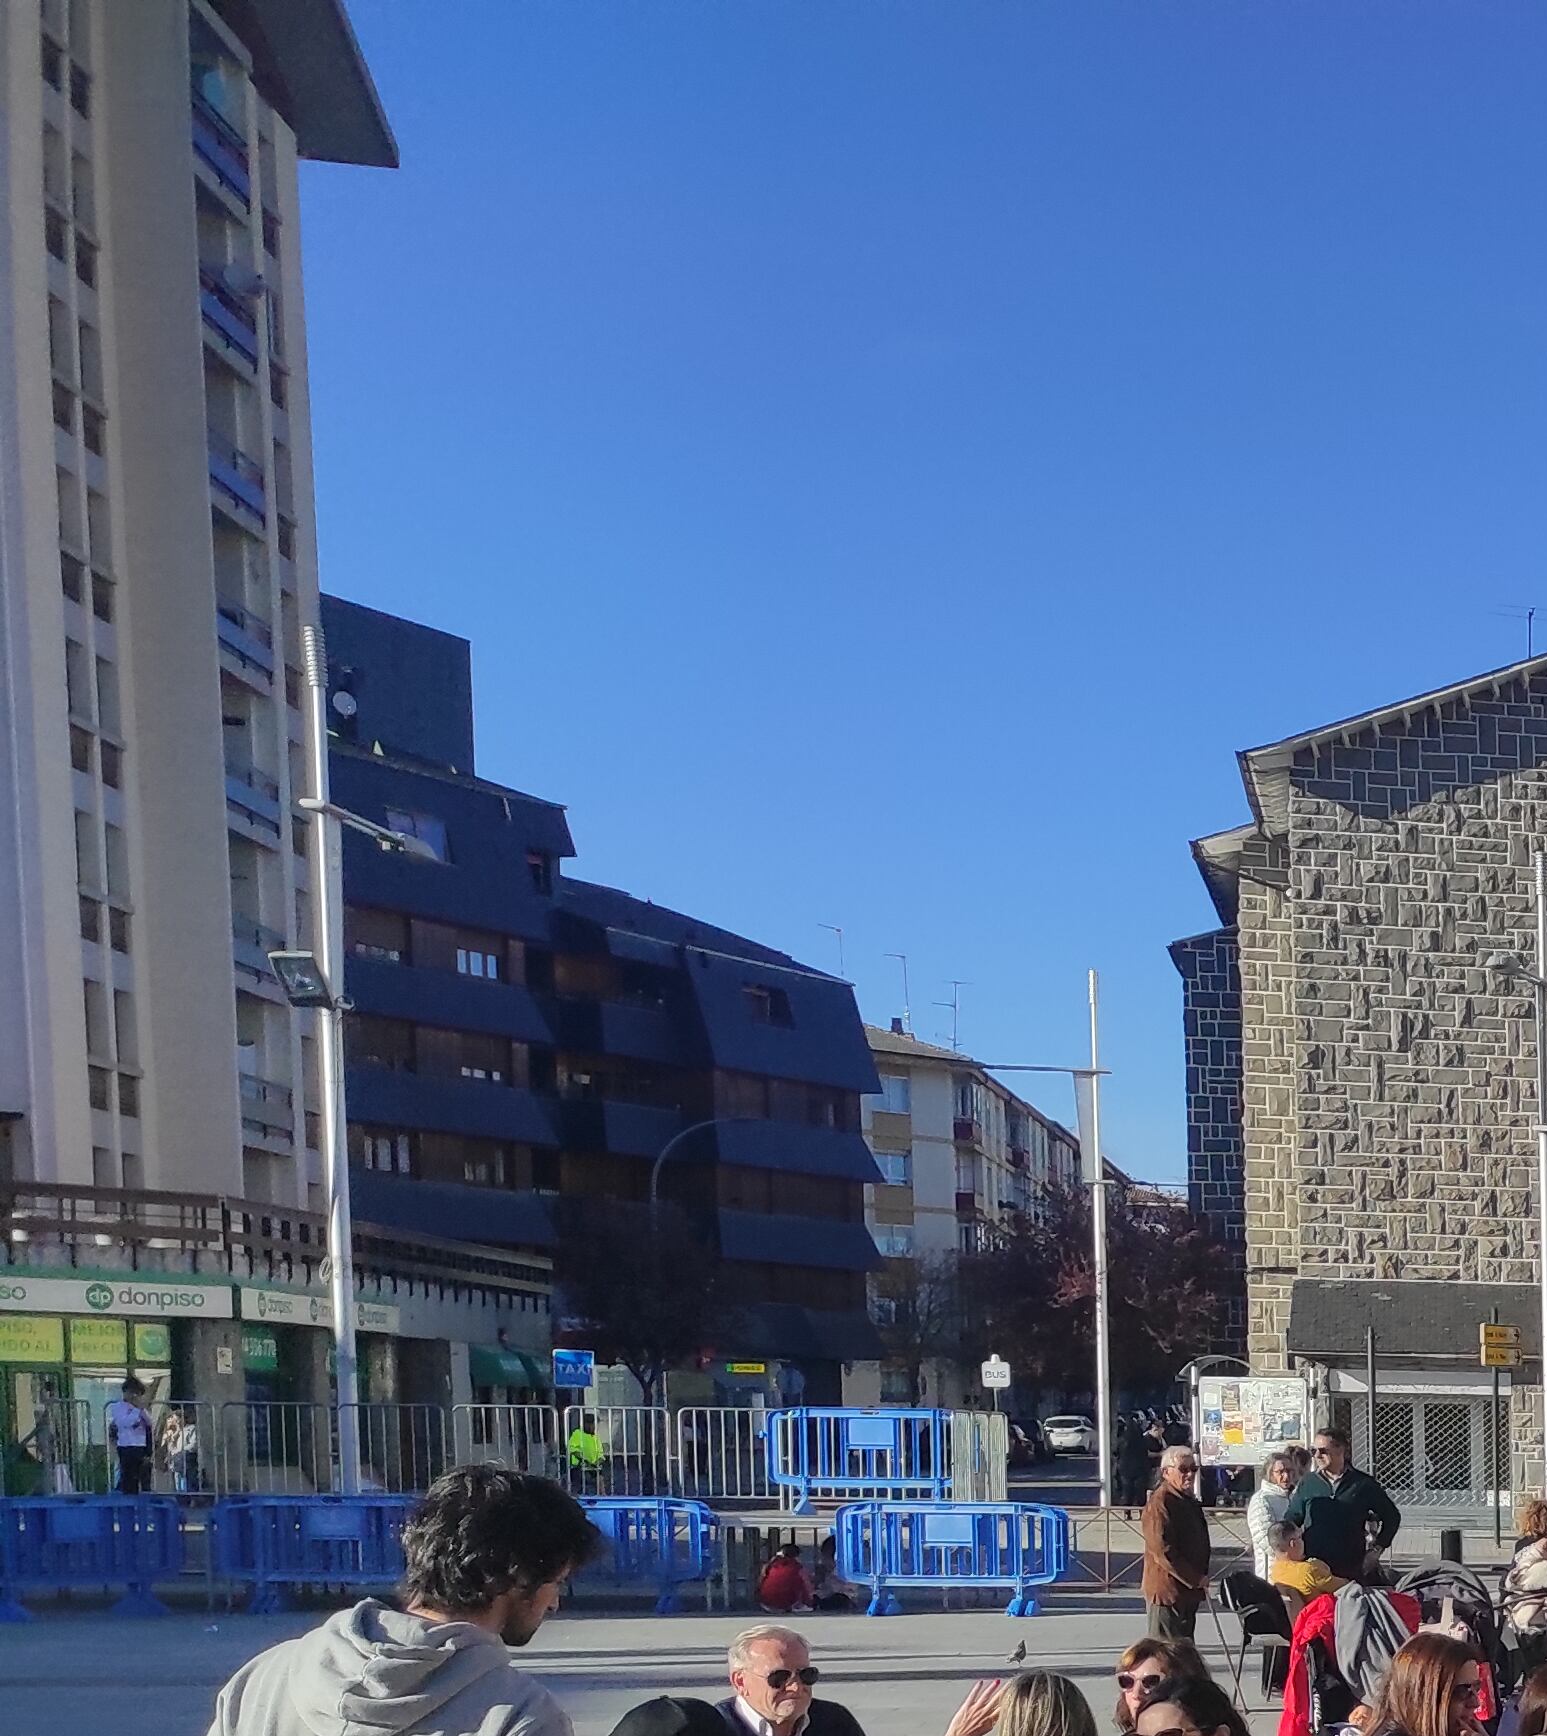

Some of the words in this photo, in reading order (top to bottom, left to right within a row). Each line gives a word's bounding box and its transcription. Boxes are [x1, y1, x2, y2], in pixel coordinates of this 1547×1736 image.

[118, 1286, 205, 1311] donpiso
[556, 1363, 591, 1375] TAXI
[985, 1370, 1007, 1379] BUS
